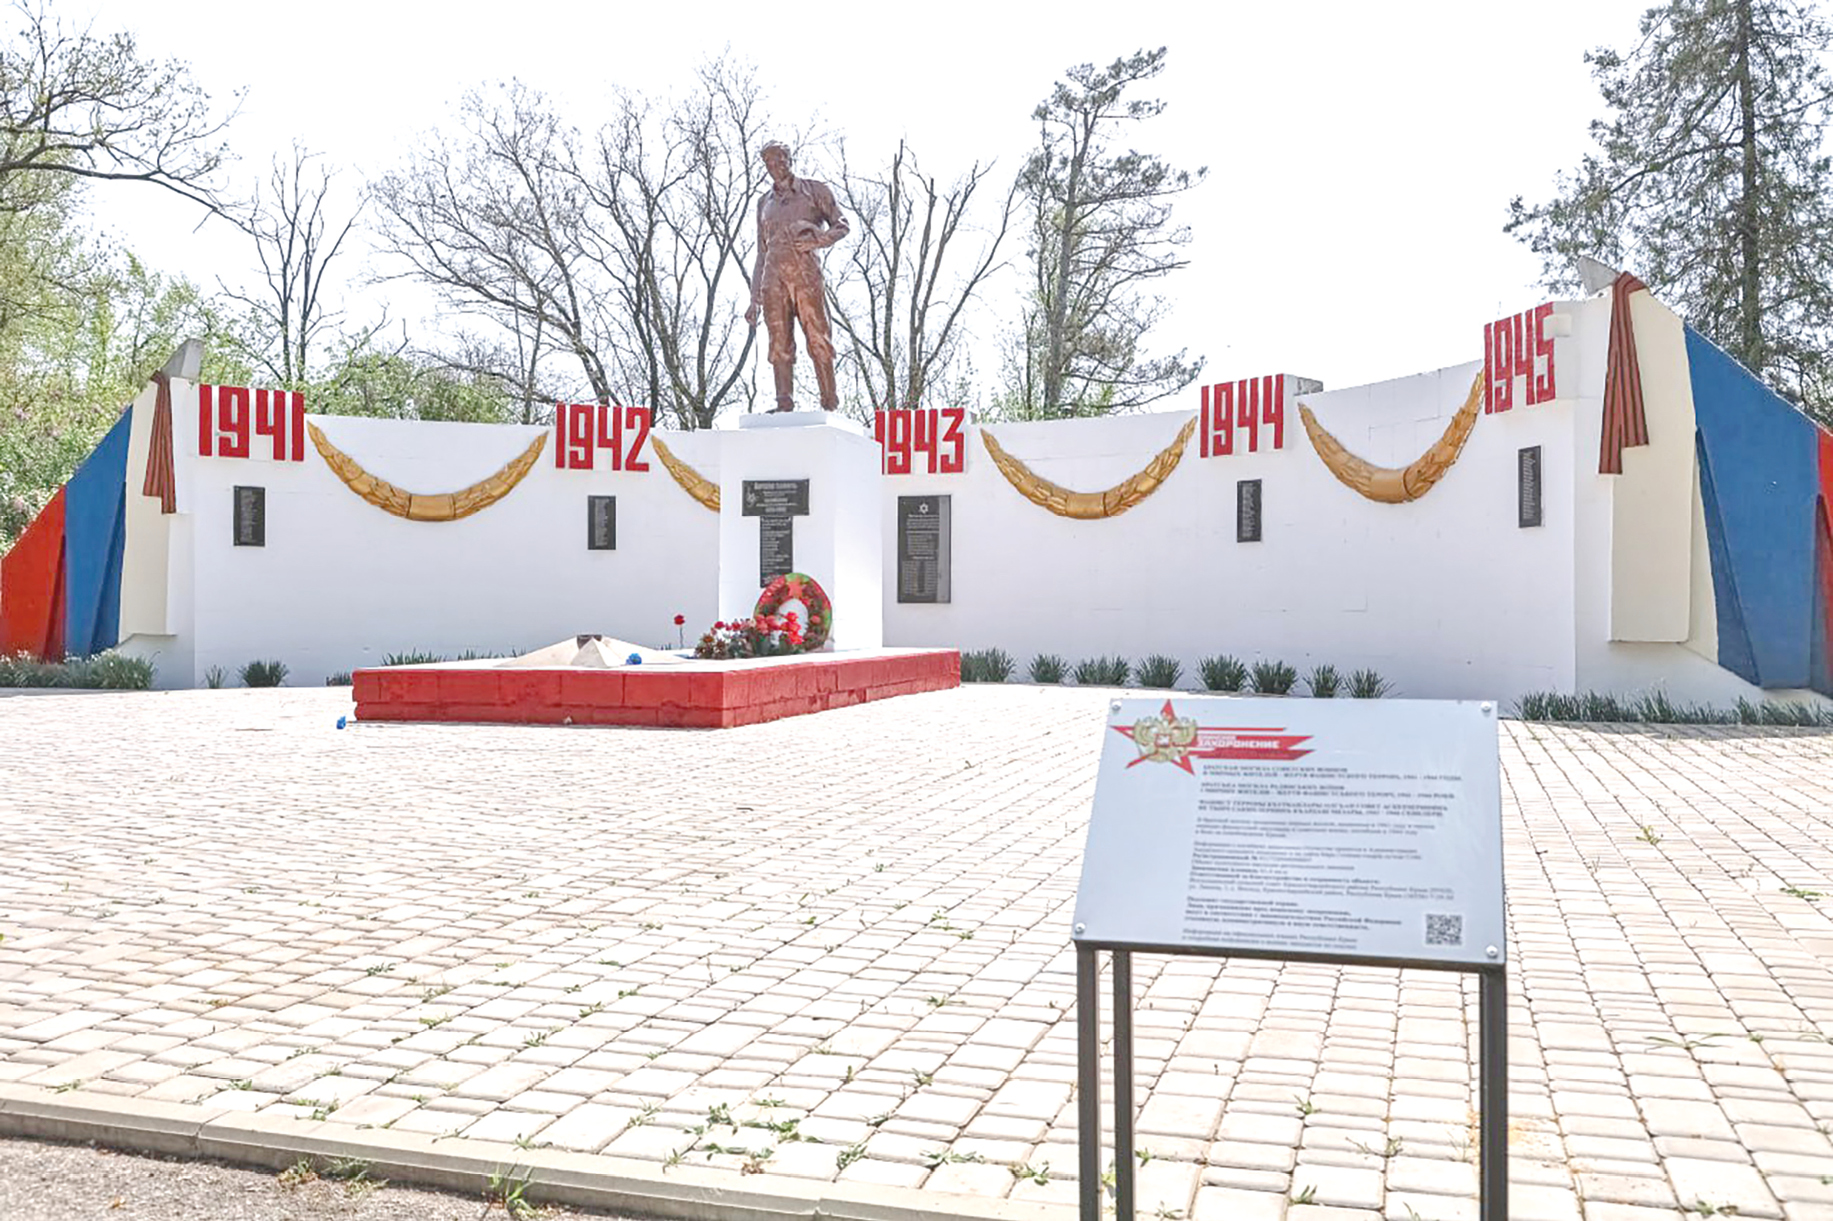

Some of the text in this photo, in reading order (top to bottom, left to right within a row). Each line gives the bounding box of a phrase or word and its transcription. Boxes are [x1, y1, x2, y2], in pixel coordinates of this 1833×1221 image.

[1484, 301, 1556, 415] 1945
[199, 384, 304, 462] 1941
[556, 401, 651, 472] 1942
[875, 407, 965, 475] 1943
[1200, 373, 1284, 458] 1944
[1197, 738, 1281, 748] ЗАХОРОНЕНИЕ
